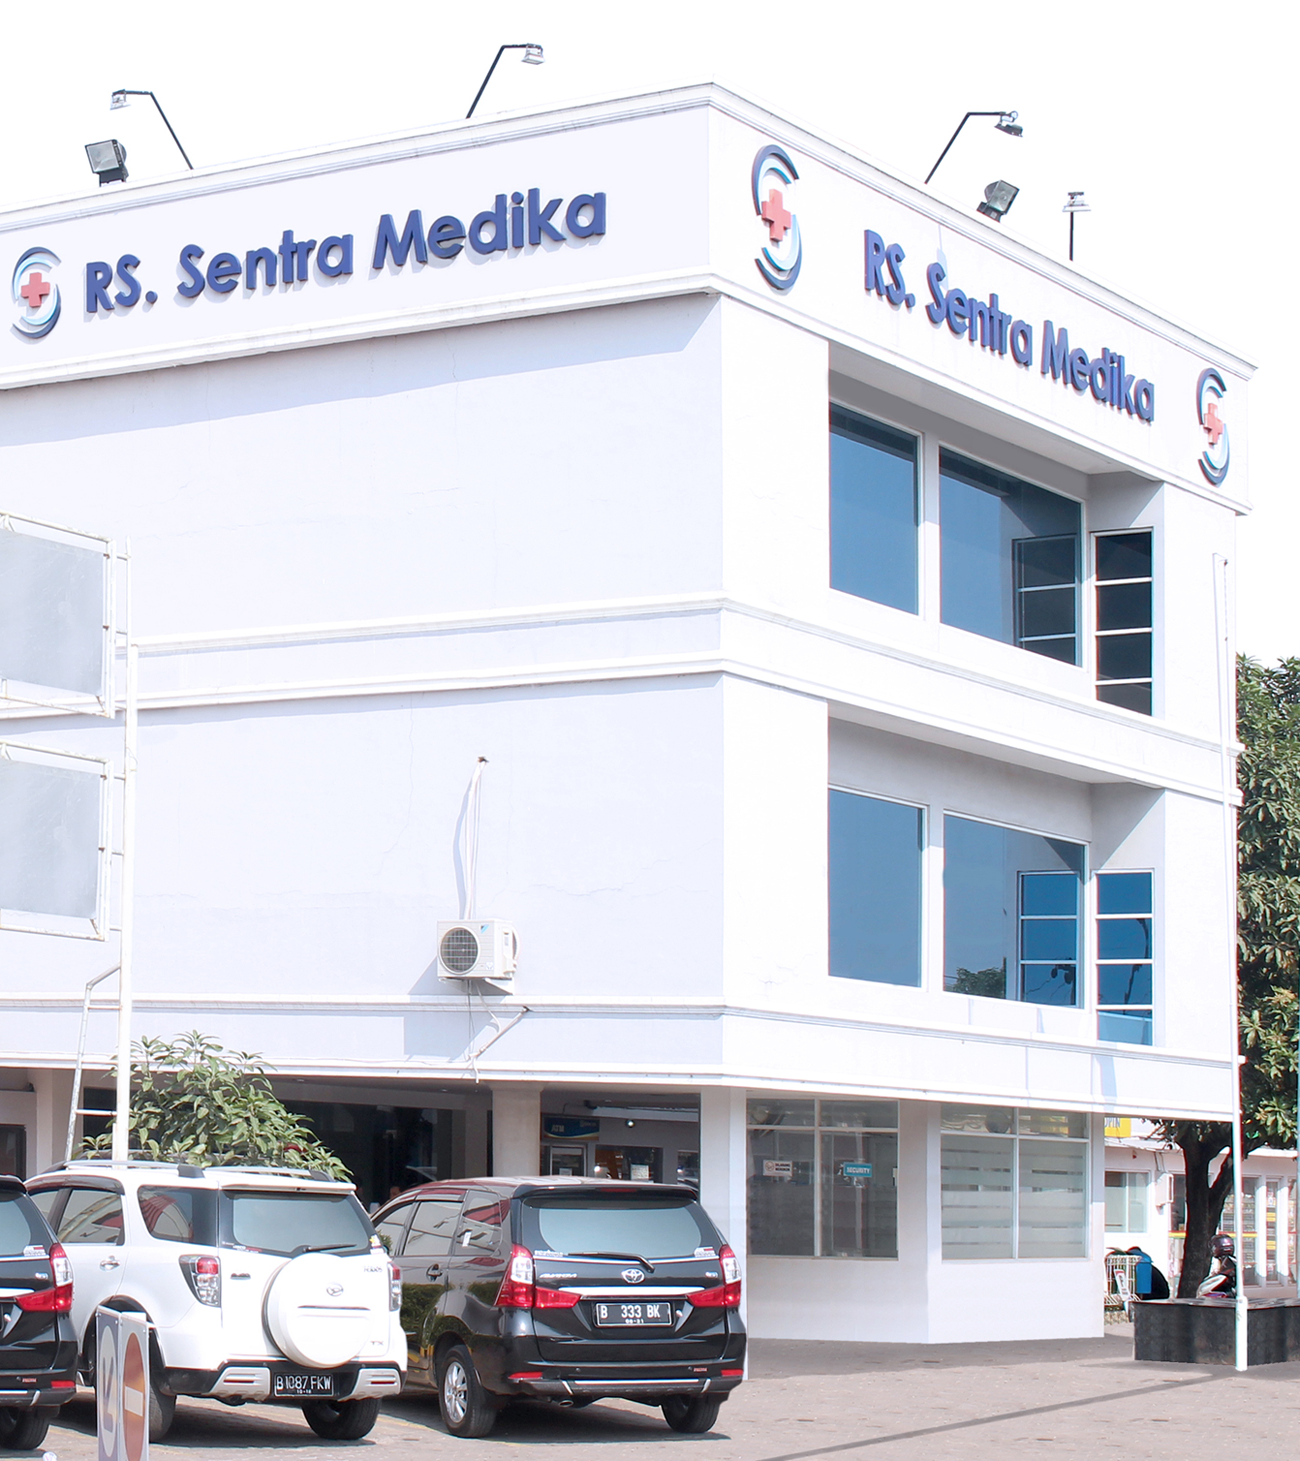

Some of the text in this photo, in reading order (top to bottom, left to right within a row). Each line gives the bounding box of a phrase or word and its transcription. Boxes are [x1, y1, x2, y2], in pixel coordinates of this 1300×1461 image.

[86, 187, 607, 313] RS. Sentra Medika
[864, 229, 1155, 423] RS. Sentra Medika
[551, 1124, 565, 1133] ATM
[846, 1166, 870, 1174] SECURITY
[600, 1304, 661, 1319] B 333 BK
[276, 1375, 331, 1390] B 1087 FKW
